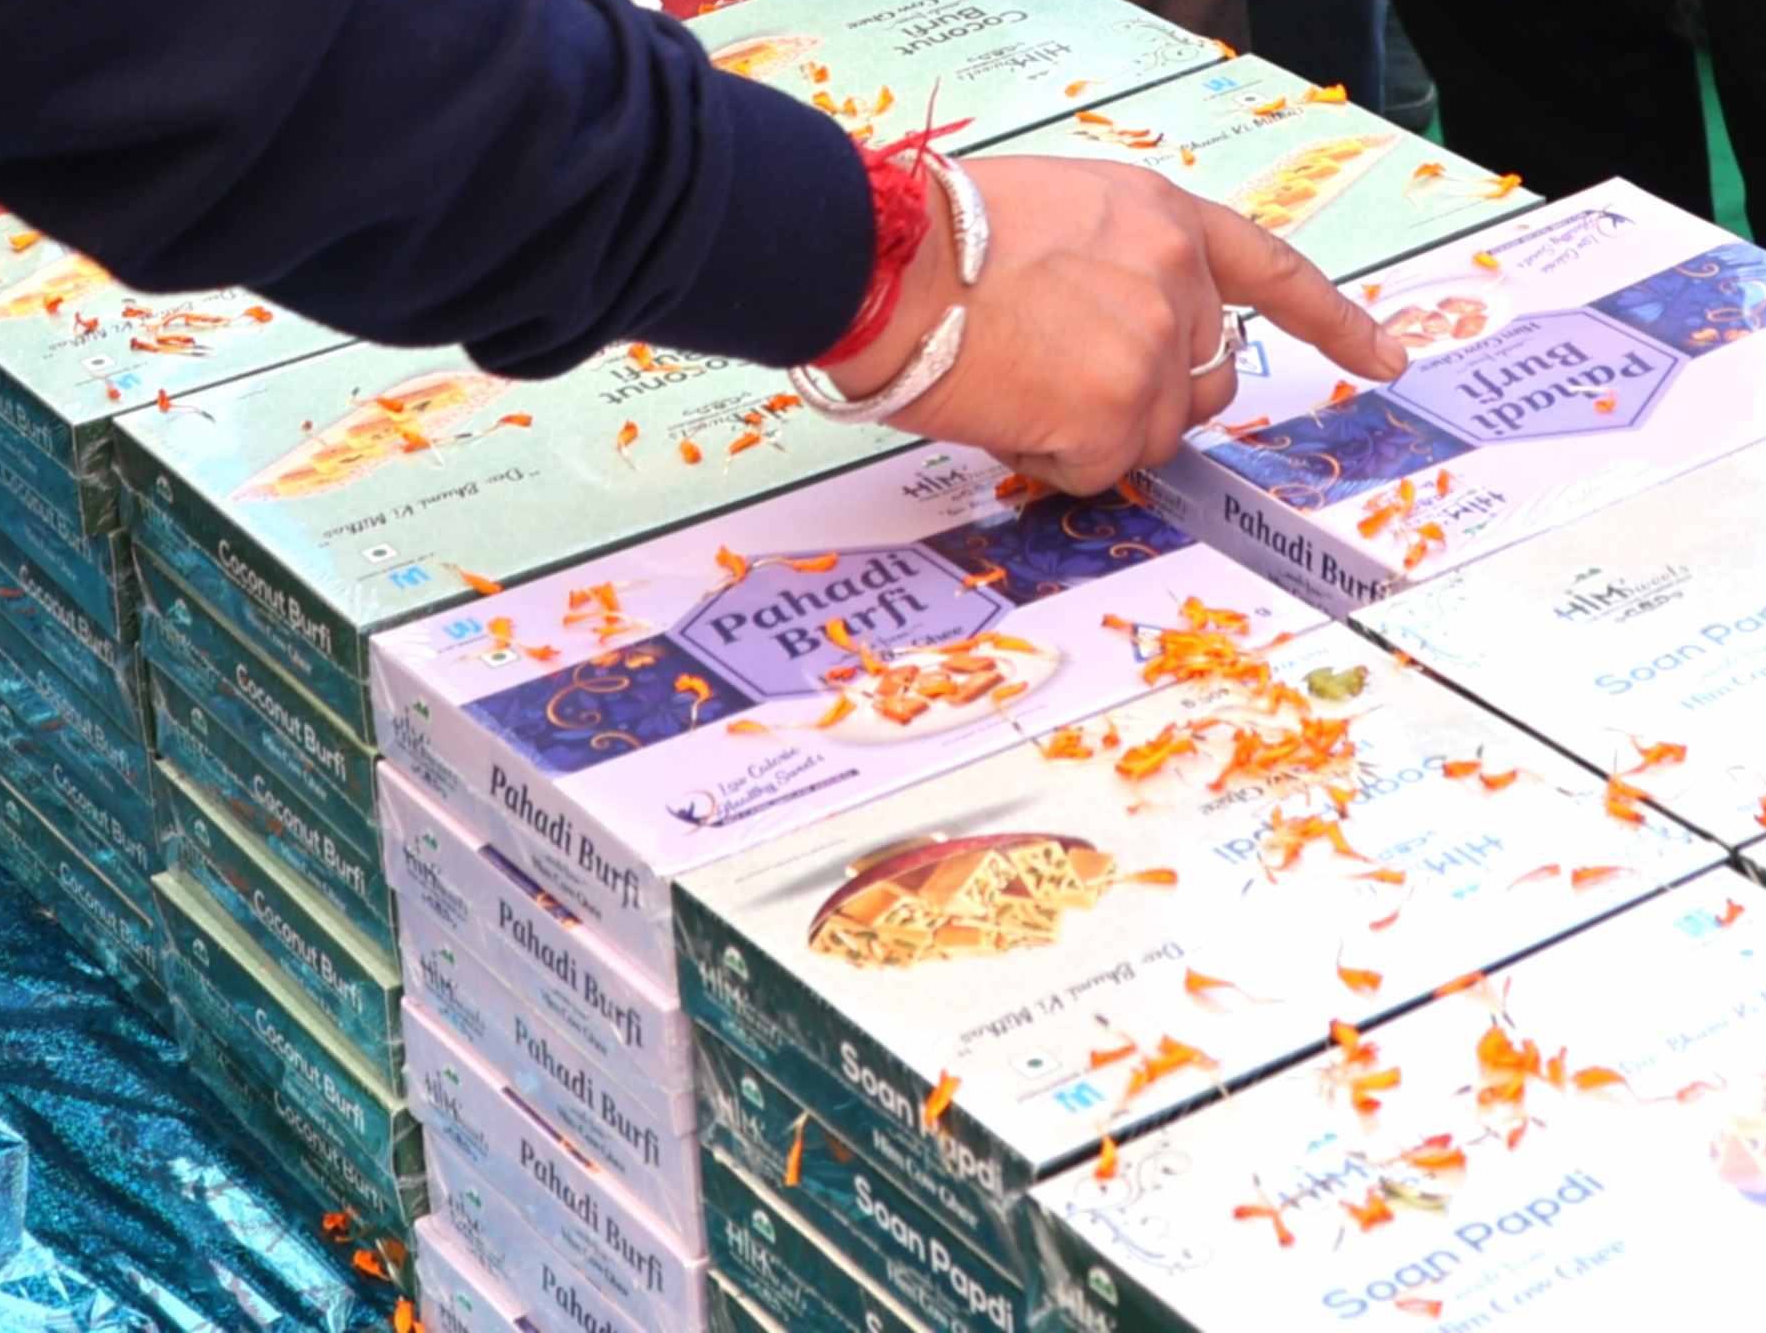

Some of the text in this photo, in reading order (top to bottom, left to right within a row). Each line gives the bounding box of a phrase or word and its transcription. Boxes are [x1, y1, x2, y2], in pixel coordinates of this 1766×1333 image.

[893, 9, 1029, 57] Coconut
[900, 5, 986, 39] Burfi
[1455, 340, 1591, 404] Burfi
[1470, 351, 1657, 437] Pahadi
[418, 481, 481, 510] Bhumi
[1222, 493, 1315, 573] Pahadi
[216, 539, 333, 656] Coconut Burfi
[708, 552, 921, 646] Pahadi
[235, 662, 302, 742] Coconut
[302, 721, 349, 783] Burfi
[1595, 641, 1706, 697] Soan
[52, 762, 110, 838] Coconut
[252, 773, 368, 897] Coconut Burfi
[490, 764, 574, 857] Pahadi
[578, 835, 642, 911] Burfi
[58, 861, 118, 939] Coconut
[252, 888, 365, 1015] Coconut Burfi
[498, 898, 579, 993] Pahadi
[583, 968, 646, 1050] Burfi
[254, 1007, 367, 1135] Coconut Burfi
[514, 1017, 663, 1170] Pahadi Burfi
[839, 1041, 914, 1127] Soan
[273, 1087, 385, 1215] Coconut Burfi
[519, 1139, 601, 1232] Pahadi
[605, 1215, 666, 1294] Burfi
[853, 1174, 926, 1262] Soan
[929, 1235, 1015, 1333] Papdi
[1321, 1167, 1606, 1321] Soan Papdi
